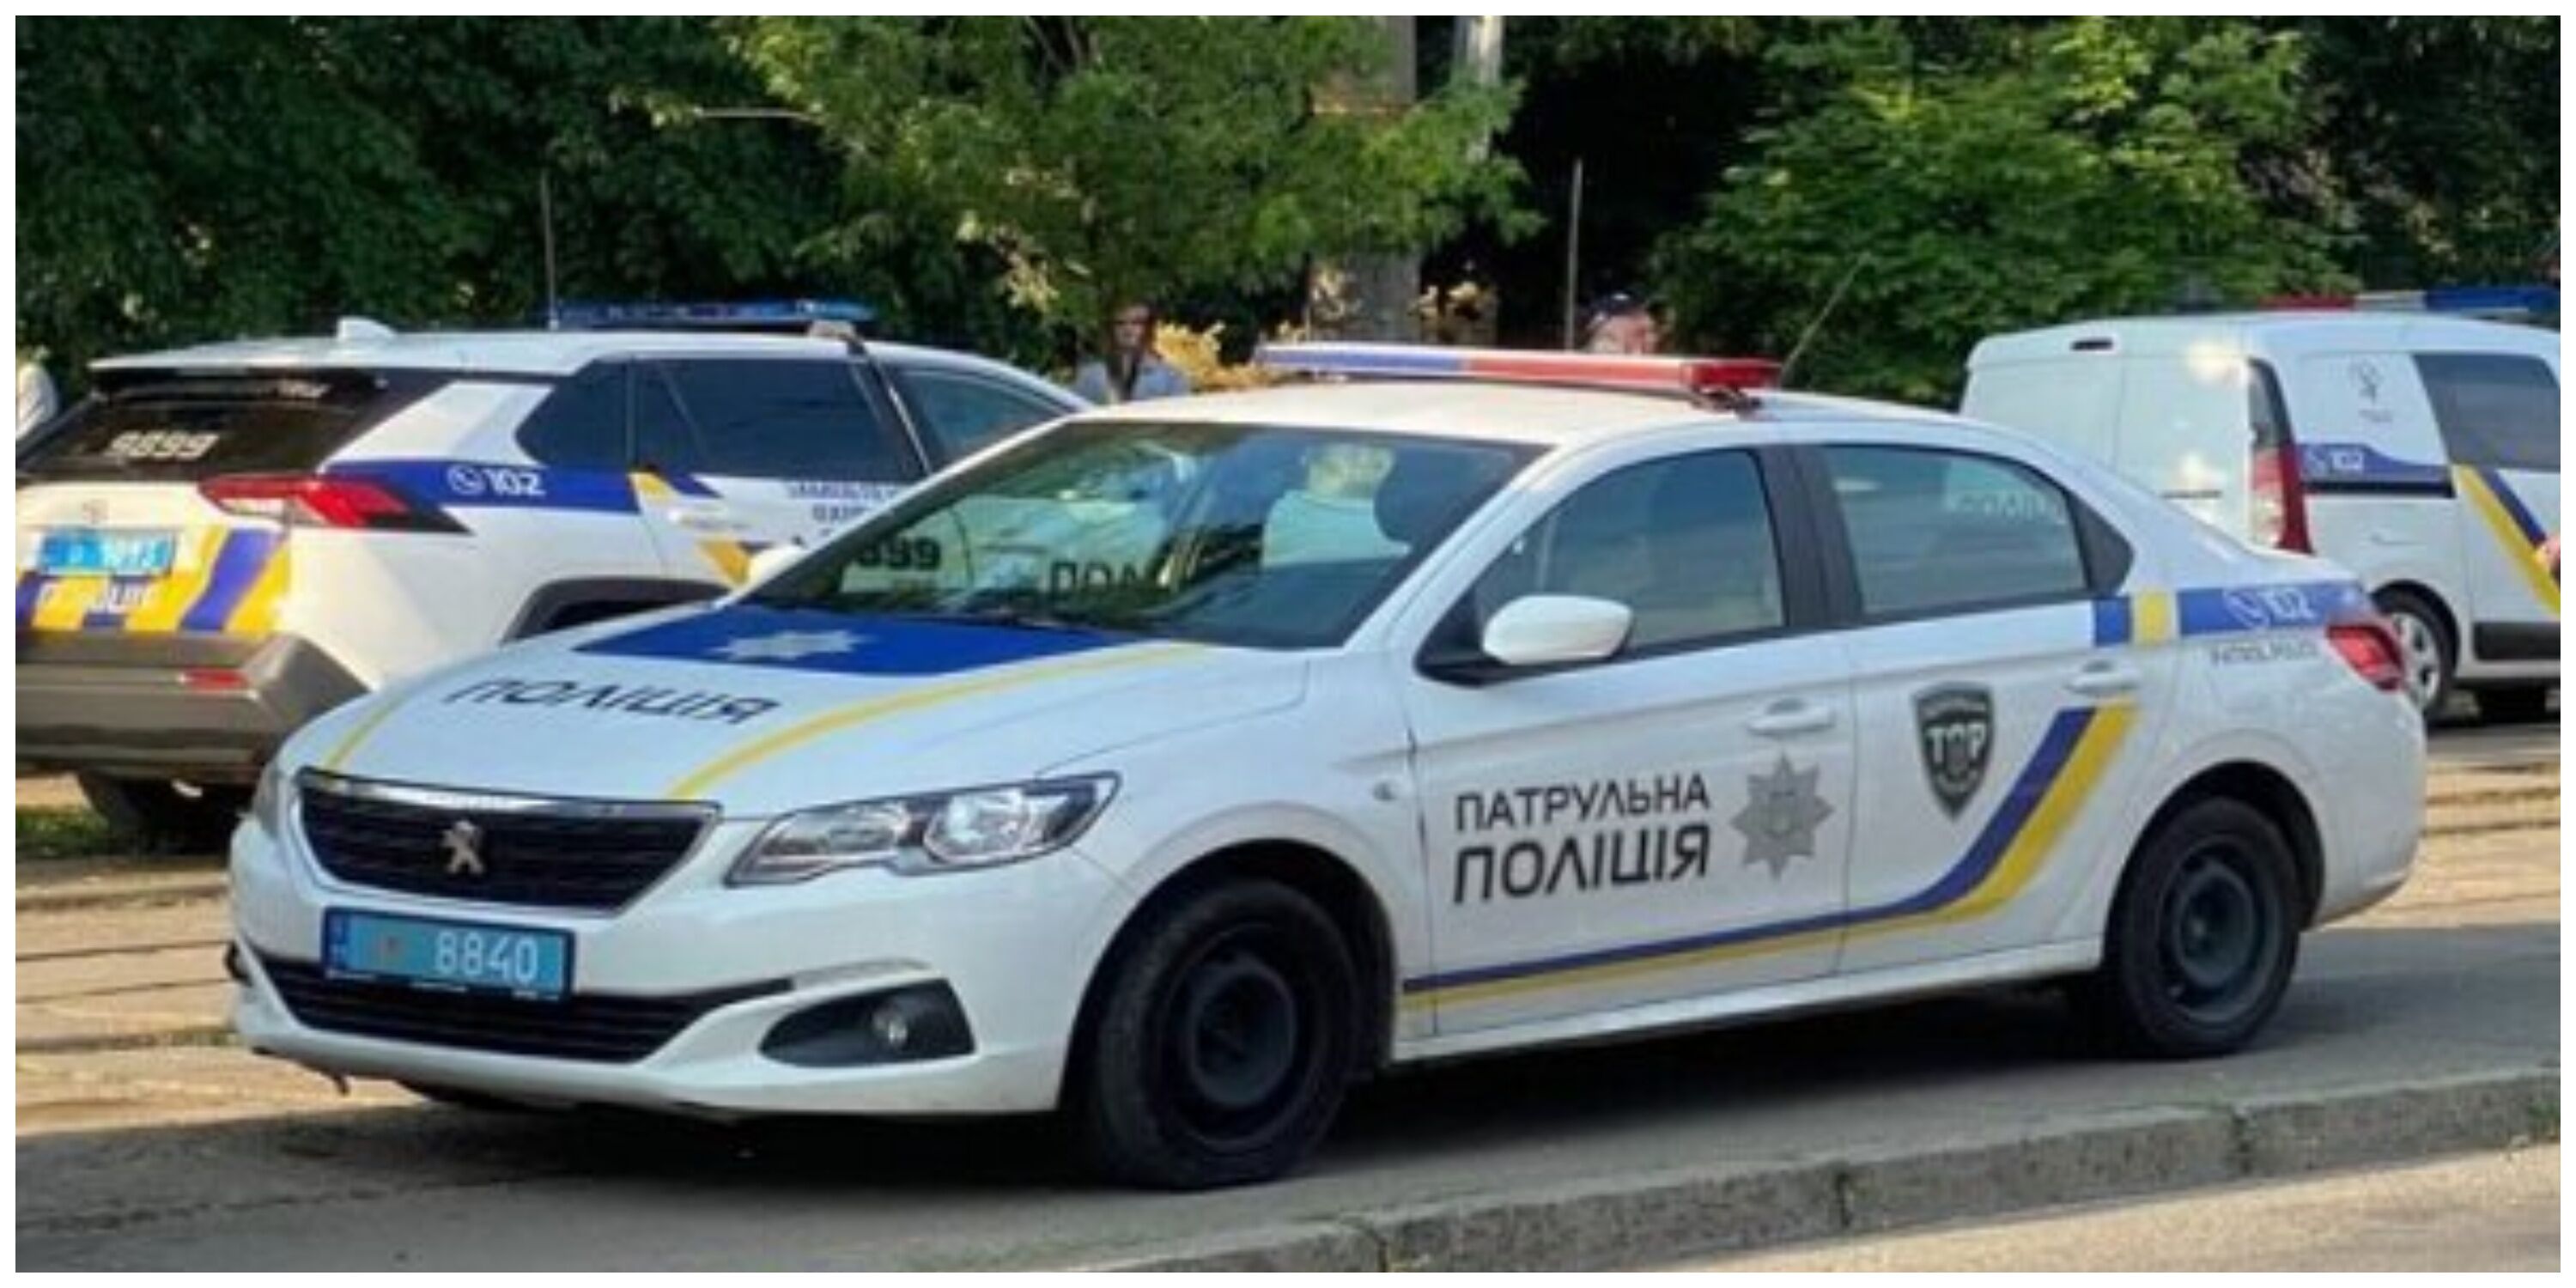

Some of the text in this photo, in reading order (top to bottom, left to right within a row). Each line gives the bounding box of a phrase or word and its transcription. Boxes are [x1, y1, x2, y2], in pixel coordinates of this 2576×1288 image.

[482, 467, 546, 496] 102
[443, 679, 781, 724] ПОЛІЦІЯ
[1454, 772, 1710, 831] ПАТРУЛЬНА
[1454, 820, 1710, 905] ПОЛІЦІЯ
[436, 930, 539, 984] 8840
